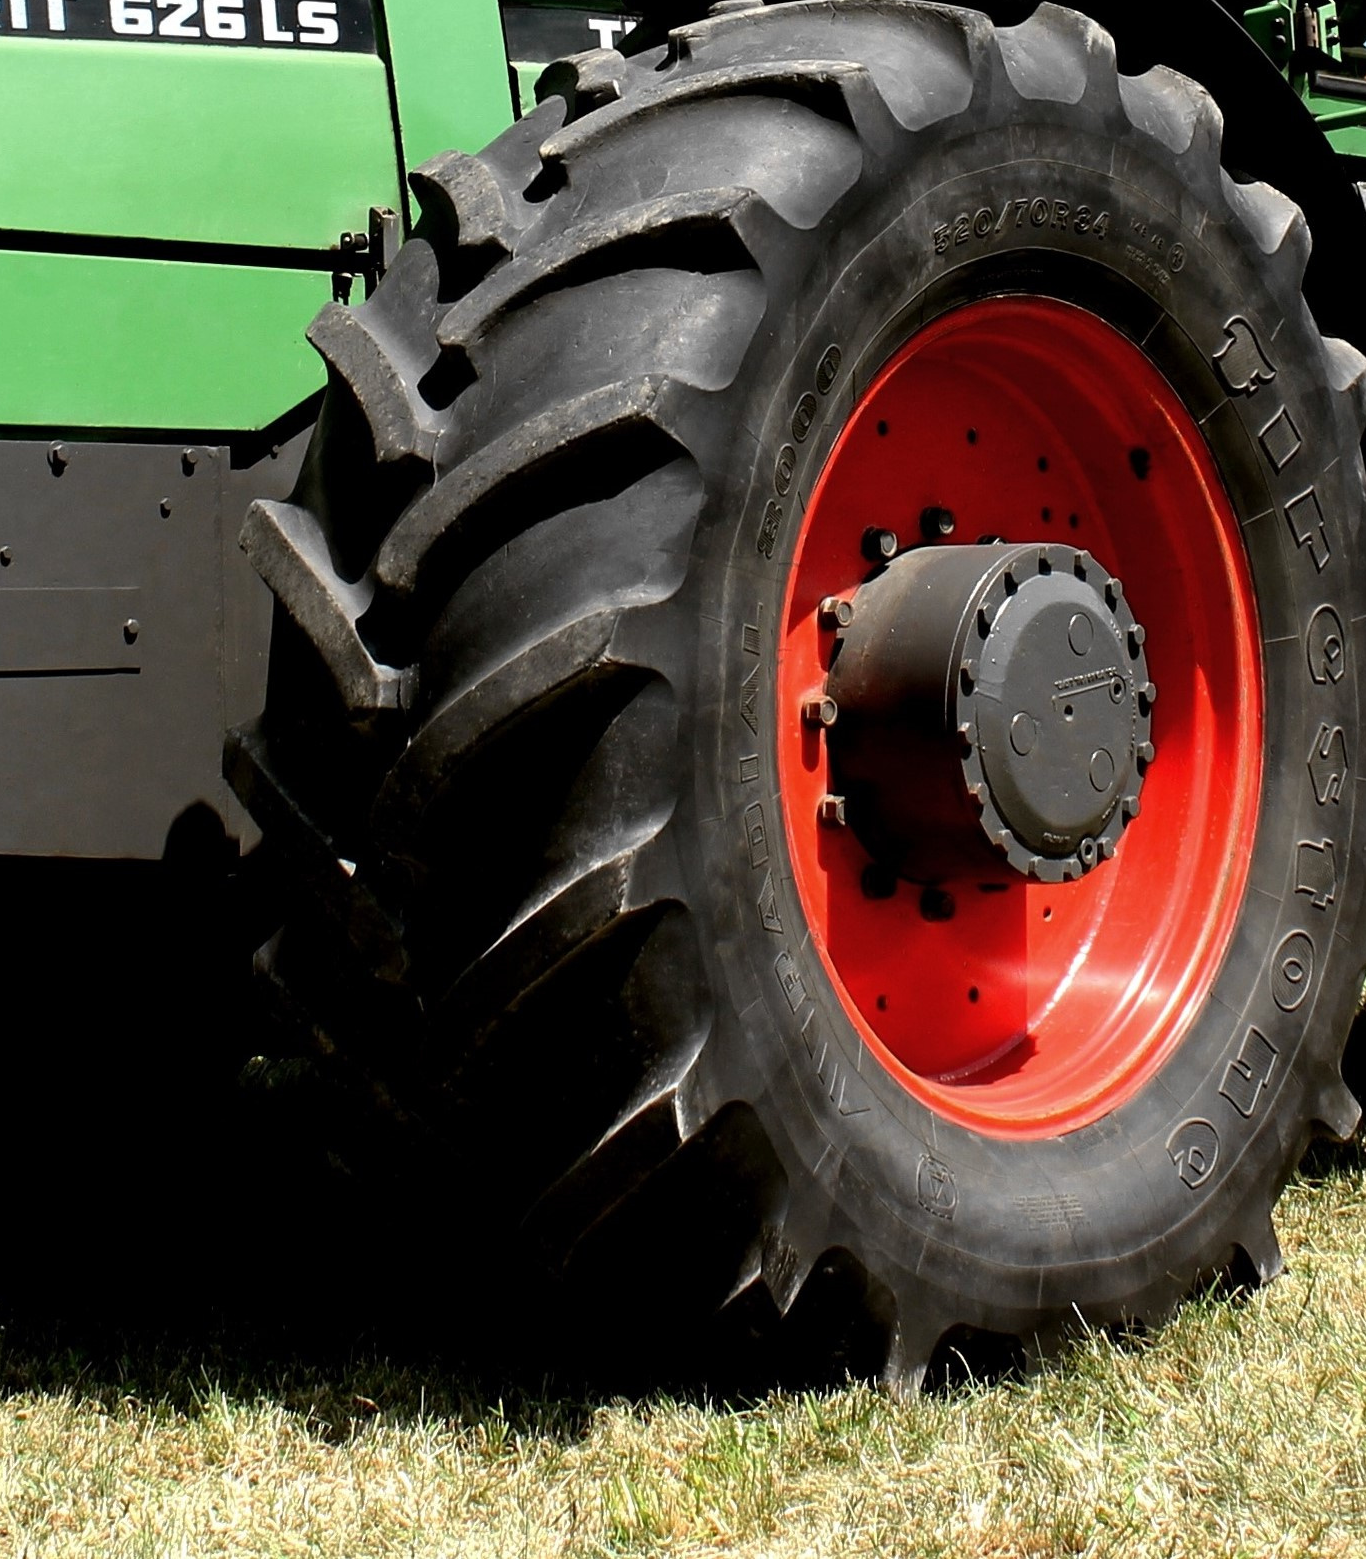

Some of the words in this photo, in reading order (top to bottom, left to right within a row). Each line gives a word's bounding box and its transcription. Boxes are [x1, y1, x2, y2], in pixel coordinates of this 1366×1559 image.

[932, 196, 1110, 254] 520/70R34
[756, 343, 842, 560] 8000
[739, 601, 807, 1015] RADIAL
